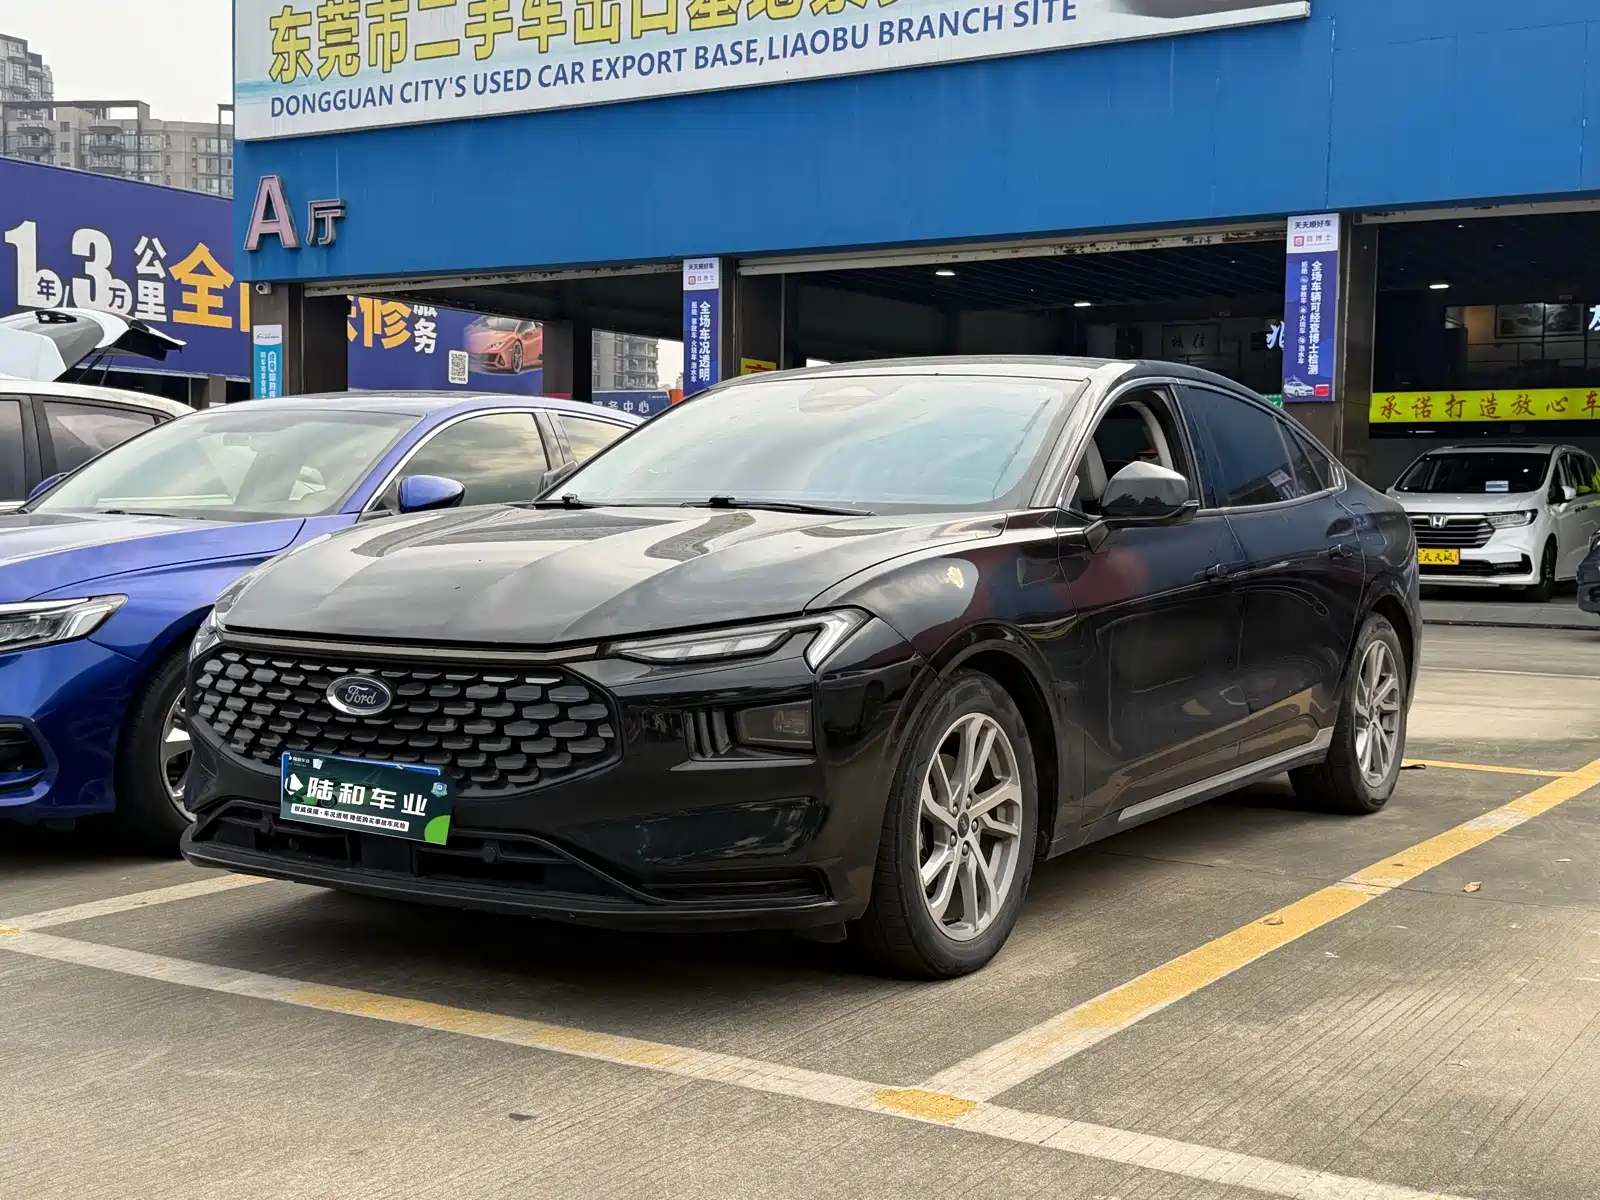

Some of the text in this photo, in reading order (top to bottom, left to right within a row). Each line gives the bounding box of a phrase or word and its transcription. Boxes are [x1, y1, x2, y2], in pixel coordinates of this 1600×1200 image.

[270, 84, 394, 118] DONGGUAN
[400, 74, 467, 103] CITY'S
[473, 67, 532, 97] USED
[538, 60, 585, 89] CAR
[592, 47, 688, 82] EXPORT
[879, 4, 1003, 46] BRANCH
[1013, 0, 1077, 28] SITE
[699, 300, 711, 382] 全场车况透明
[1379, 390, 1600, 420] 承诺打造放心车
[344, 685, 377, 705] Ford
[306, 776, 428, 817] 陆和车业
